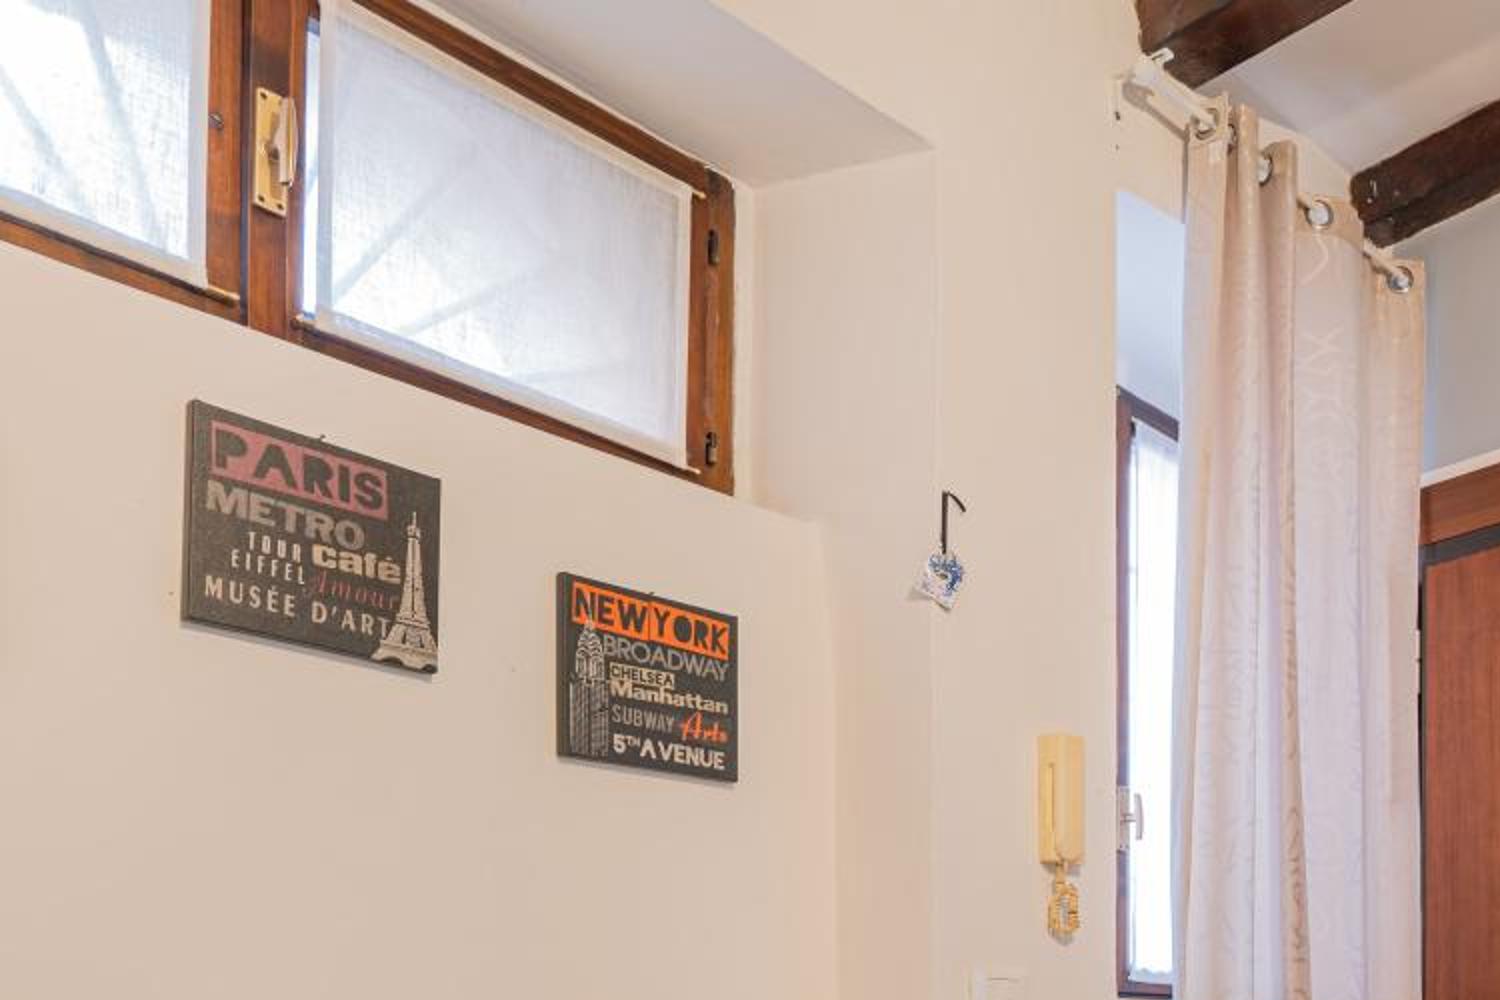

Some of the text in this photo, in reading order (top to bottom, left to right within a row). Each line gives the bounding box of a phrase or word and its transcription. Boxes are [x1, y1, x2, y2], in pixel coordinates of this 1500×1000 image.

[214, 428, 385, 512] PARIS
[205, 479, 365, 551] METRO
[247, 531, 303, 563] TOUR
[312, 544, 401, 584] café
[231, 548, 305, 585] EIFFEL
[204, 575, 394, 639] MUSÉE D'ART
[574, 588, 729, 656] NEW YORK
[603, 633, 729, 682] BROADWAY
[610, 664, 674, 686] CHELSEA
[610, 679, 729, 714] Manhattan
[611, 705, 675, 733] SUBWAY
[640, 739, 726, 770] AVENUE
